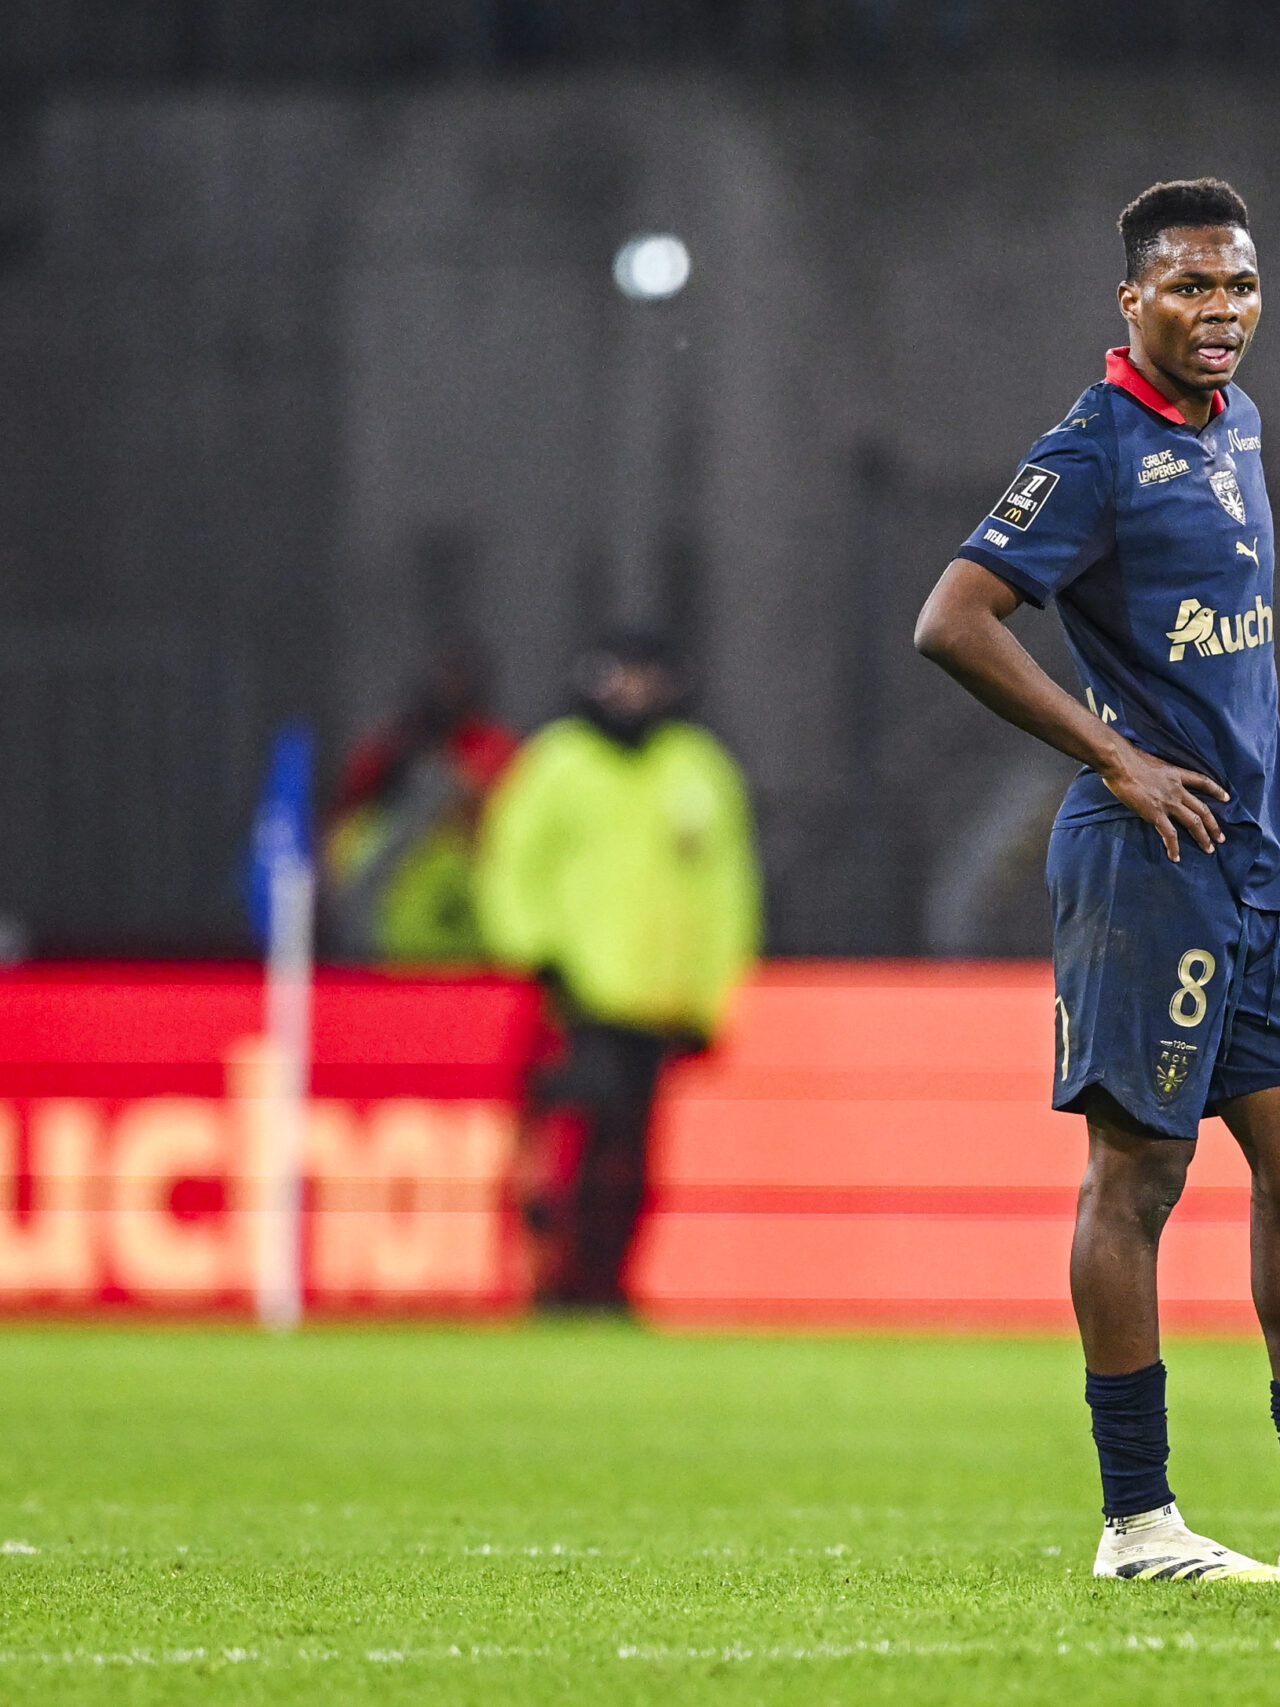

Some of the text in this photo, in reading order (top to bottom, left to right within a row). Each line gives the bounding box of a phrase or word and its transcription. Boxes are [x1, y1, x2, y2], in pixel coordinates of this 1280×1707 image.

[1137, 458, 1190, 484] LEMPEREUR
[1142, 449, 1174, 468] GROUPE
[1165, 594, 1273, 662] Auch
[1168, 948, 1216, 1028] 8
